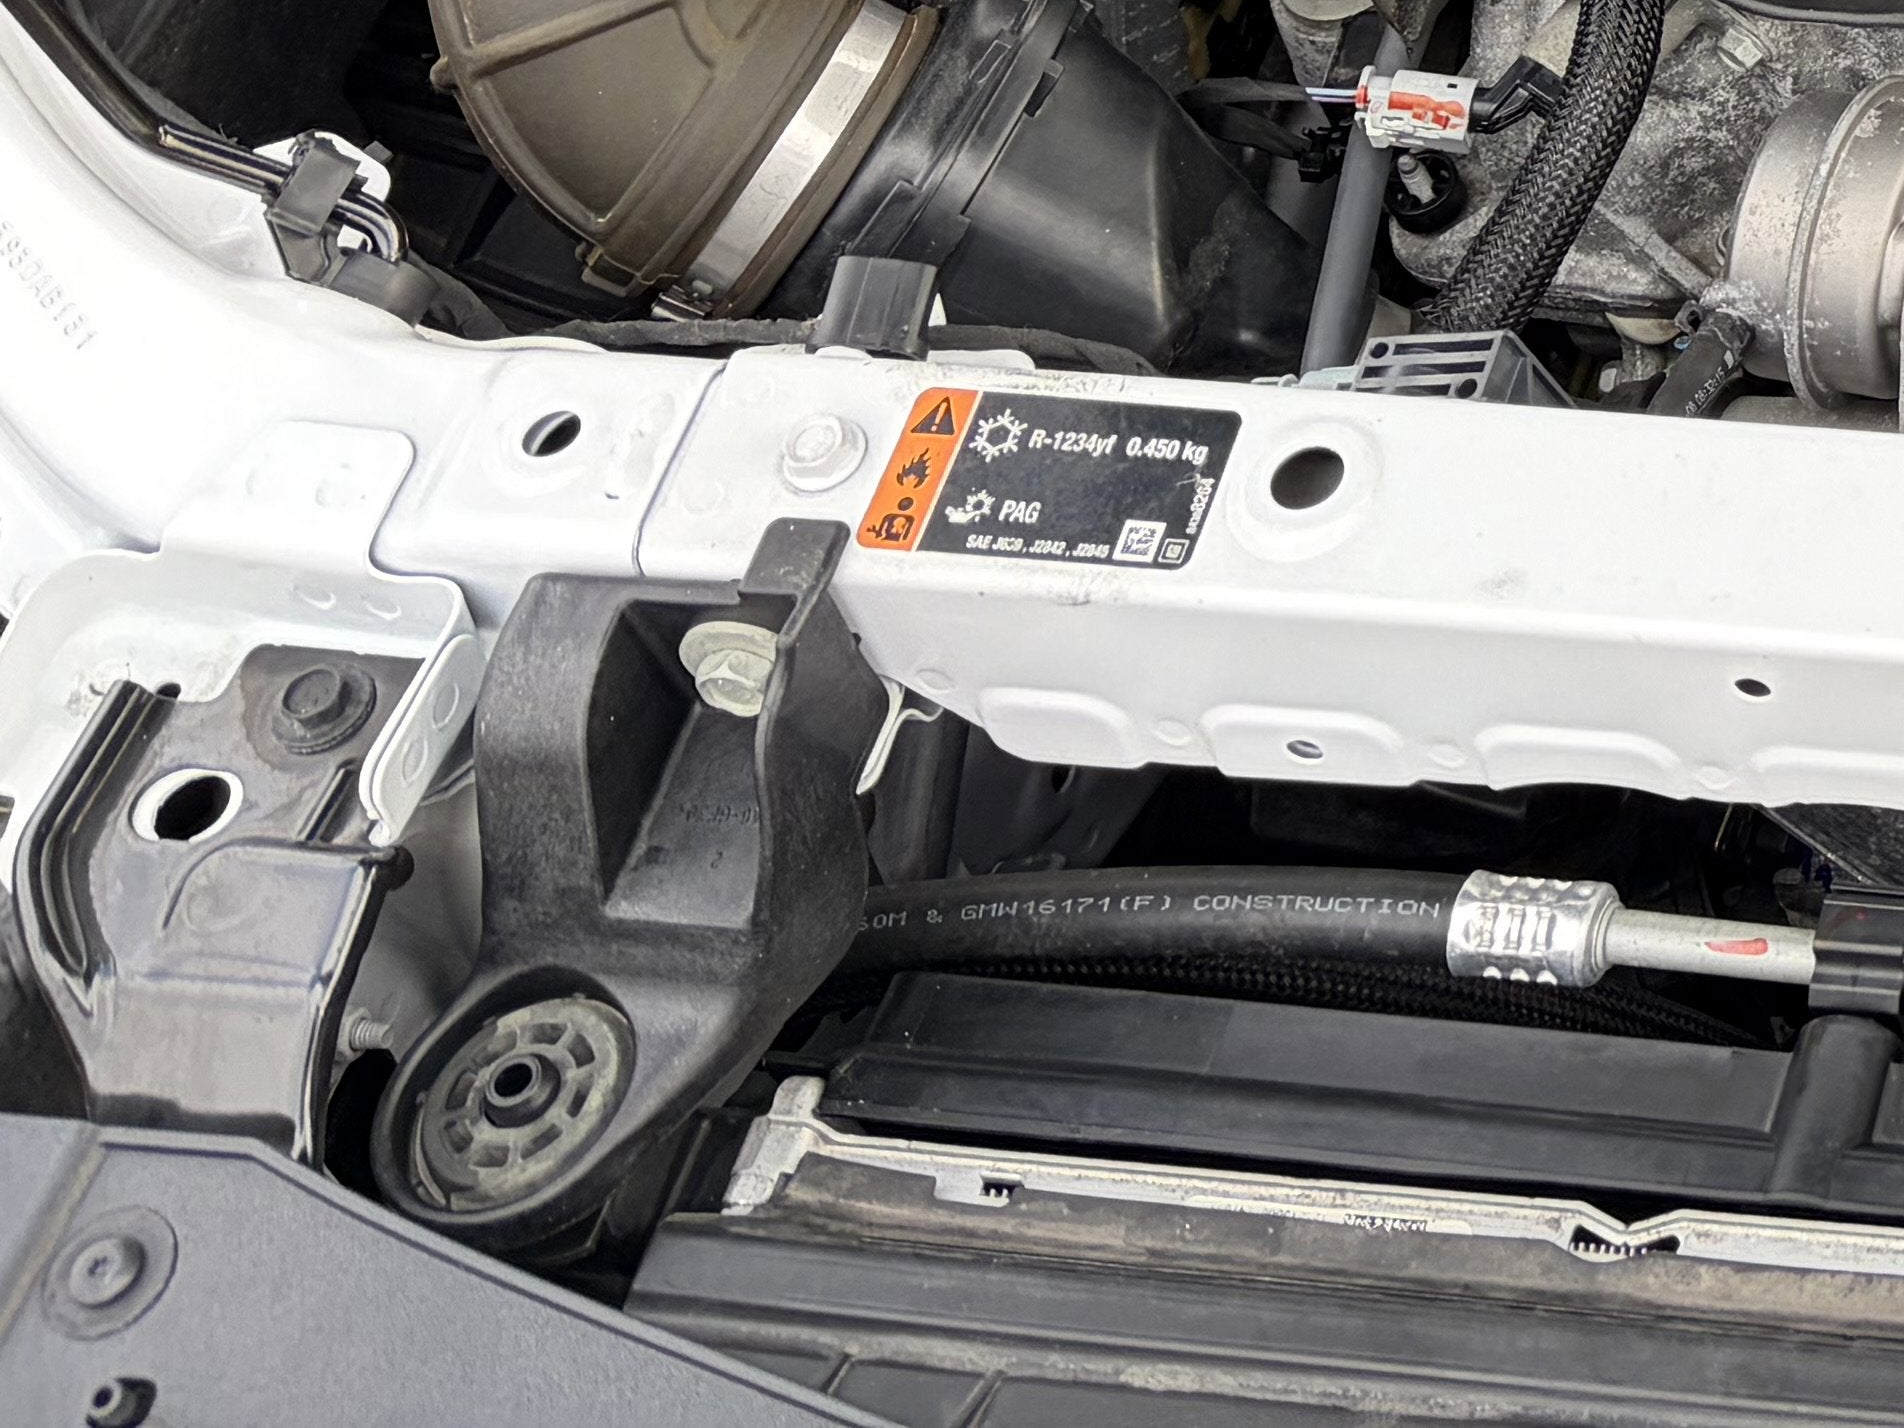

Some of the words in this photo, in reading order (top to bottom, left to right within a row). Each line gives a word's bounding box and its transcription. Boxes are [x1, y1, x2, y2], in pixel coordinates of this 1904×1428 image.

[1027, 427, 1116, 459] R-1234yf
[1124, 433, 1180, 460] 0.450
[1182, 442, 1210, 467] kg
[998, 499, 1041, 525] PAG
[1191, 893, 1442, 921] CONSTRUCTION
